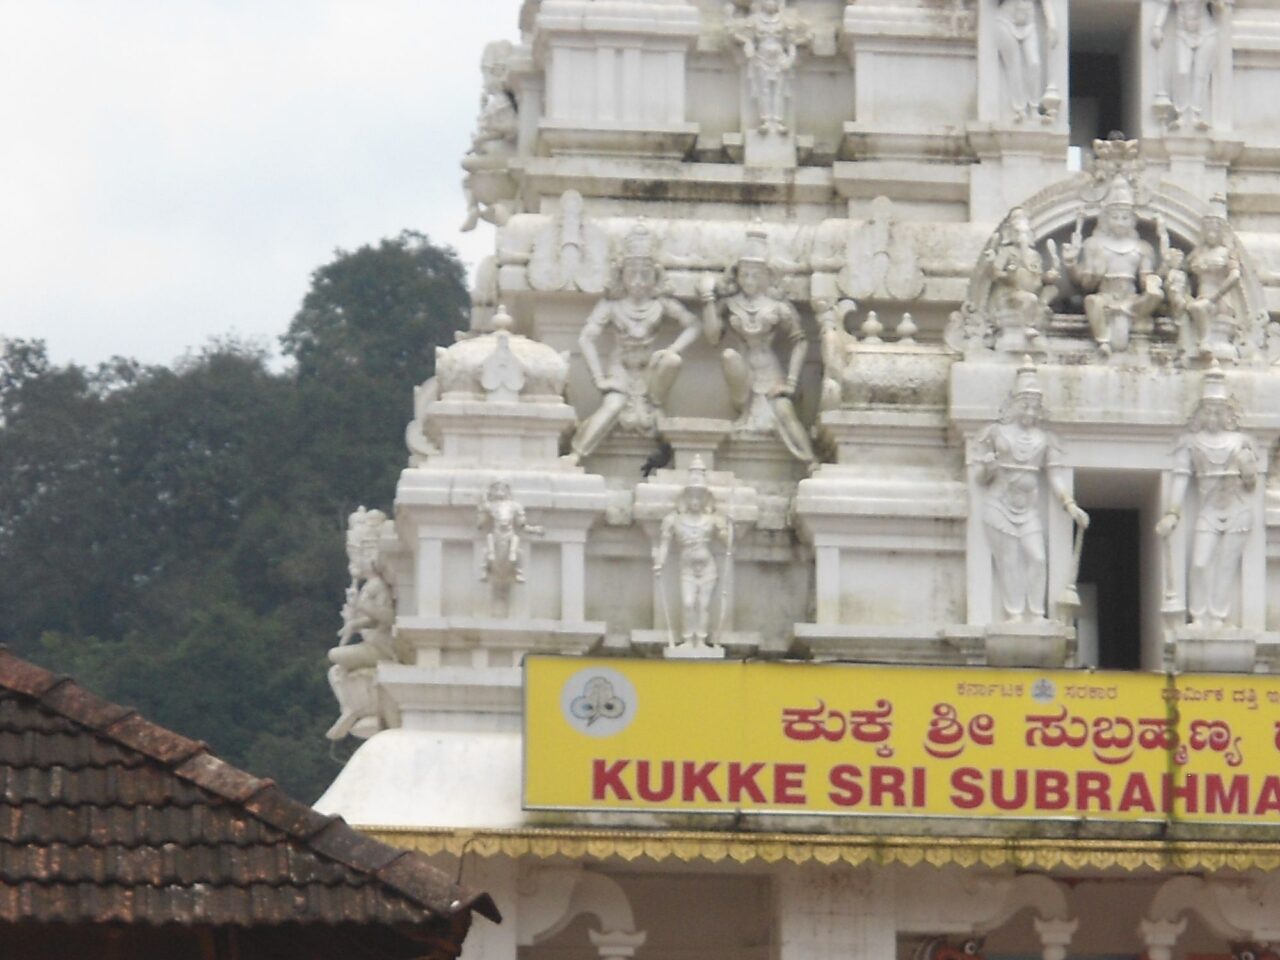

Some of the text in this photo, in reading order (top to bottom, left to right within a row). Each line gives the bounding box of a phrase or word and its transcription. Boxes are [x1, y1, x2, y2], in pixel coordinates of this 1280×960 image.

[781, 698, 895, 759] ಕುಕ್ಕೆ
[924, 702, 995, 760] ಶ್ರೀ
[1024, 704, 1244, 767] ಸುಬ್ರಹ್ಮಣ್ಯ
[591, 758, 807, 805] KUKKE
[828, 763, 927, 808] SRI
